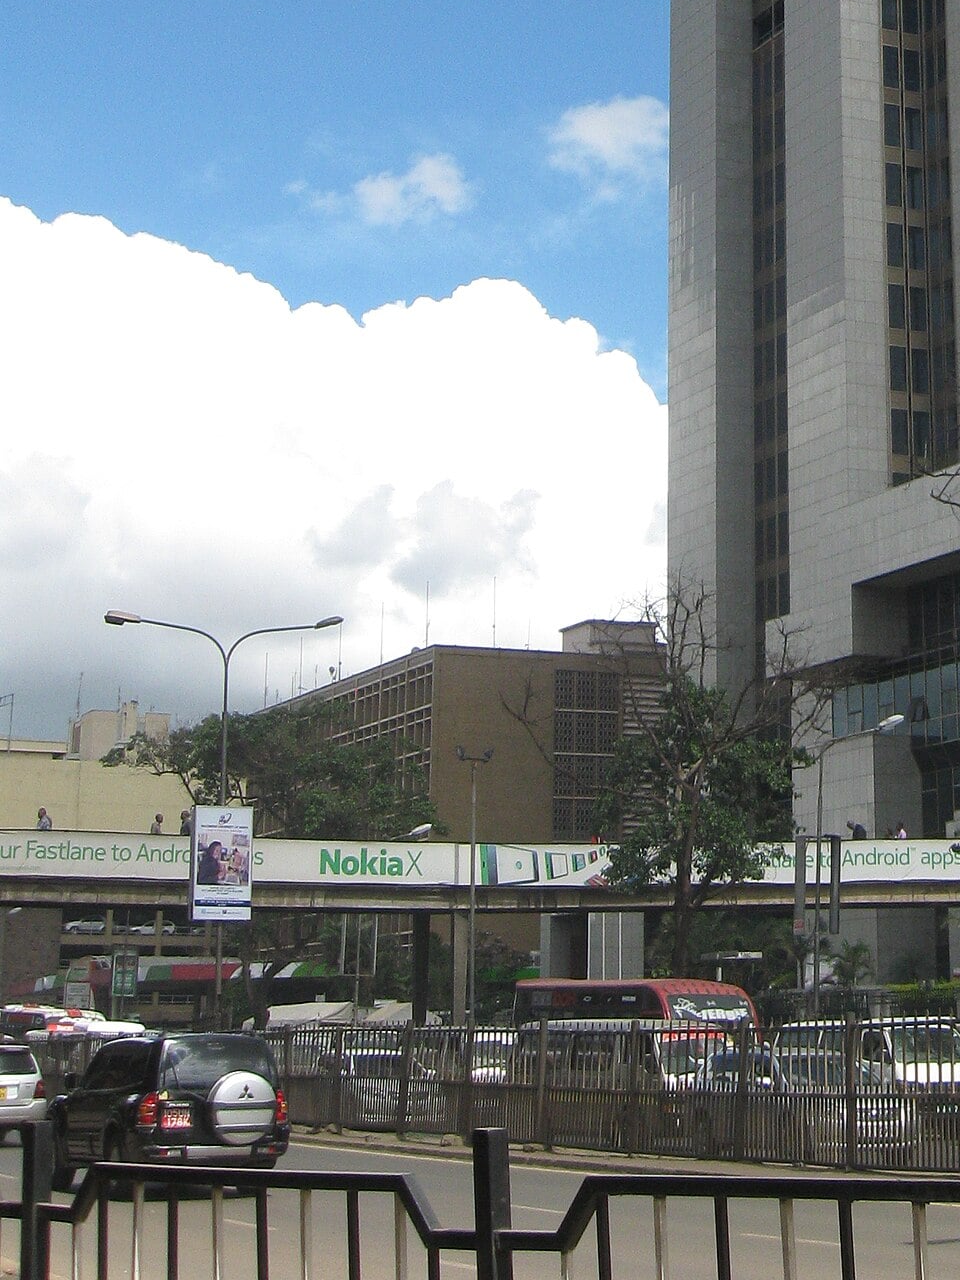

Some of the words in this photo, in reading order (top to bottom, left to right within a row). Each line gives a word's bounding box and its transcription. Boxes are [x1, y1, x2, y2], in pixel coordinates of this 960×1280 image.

[26, 839, 107, 860] Fastlane
[111, 844, 132, 861] to
[319, 848, 403, 876] Nokia
[405, 850, 423, 876] X
